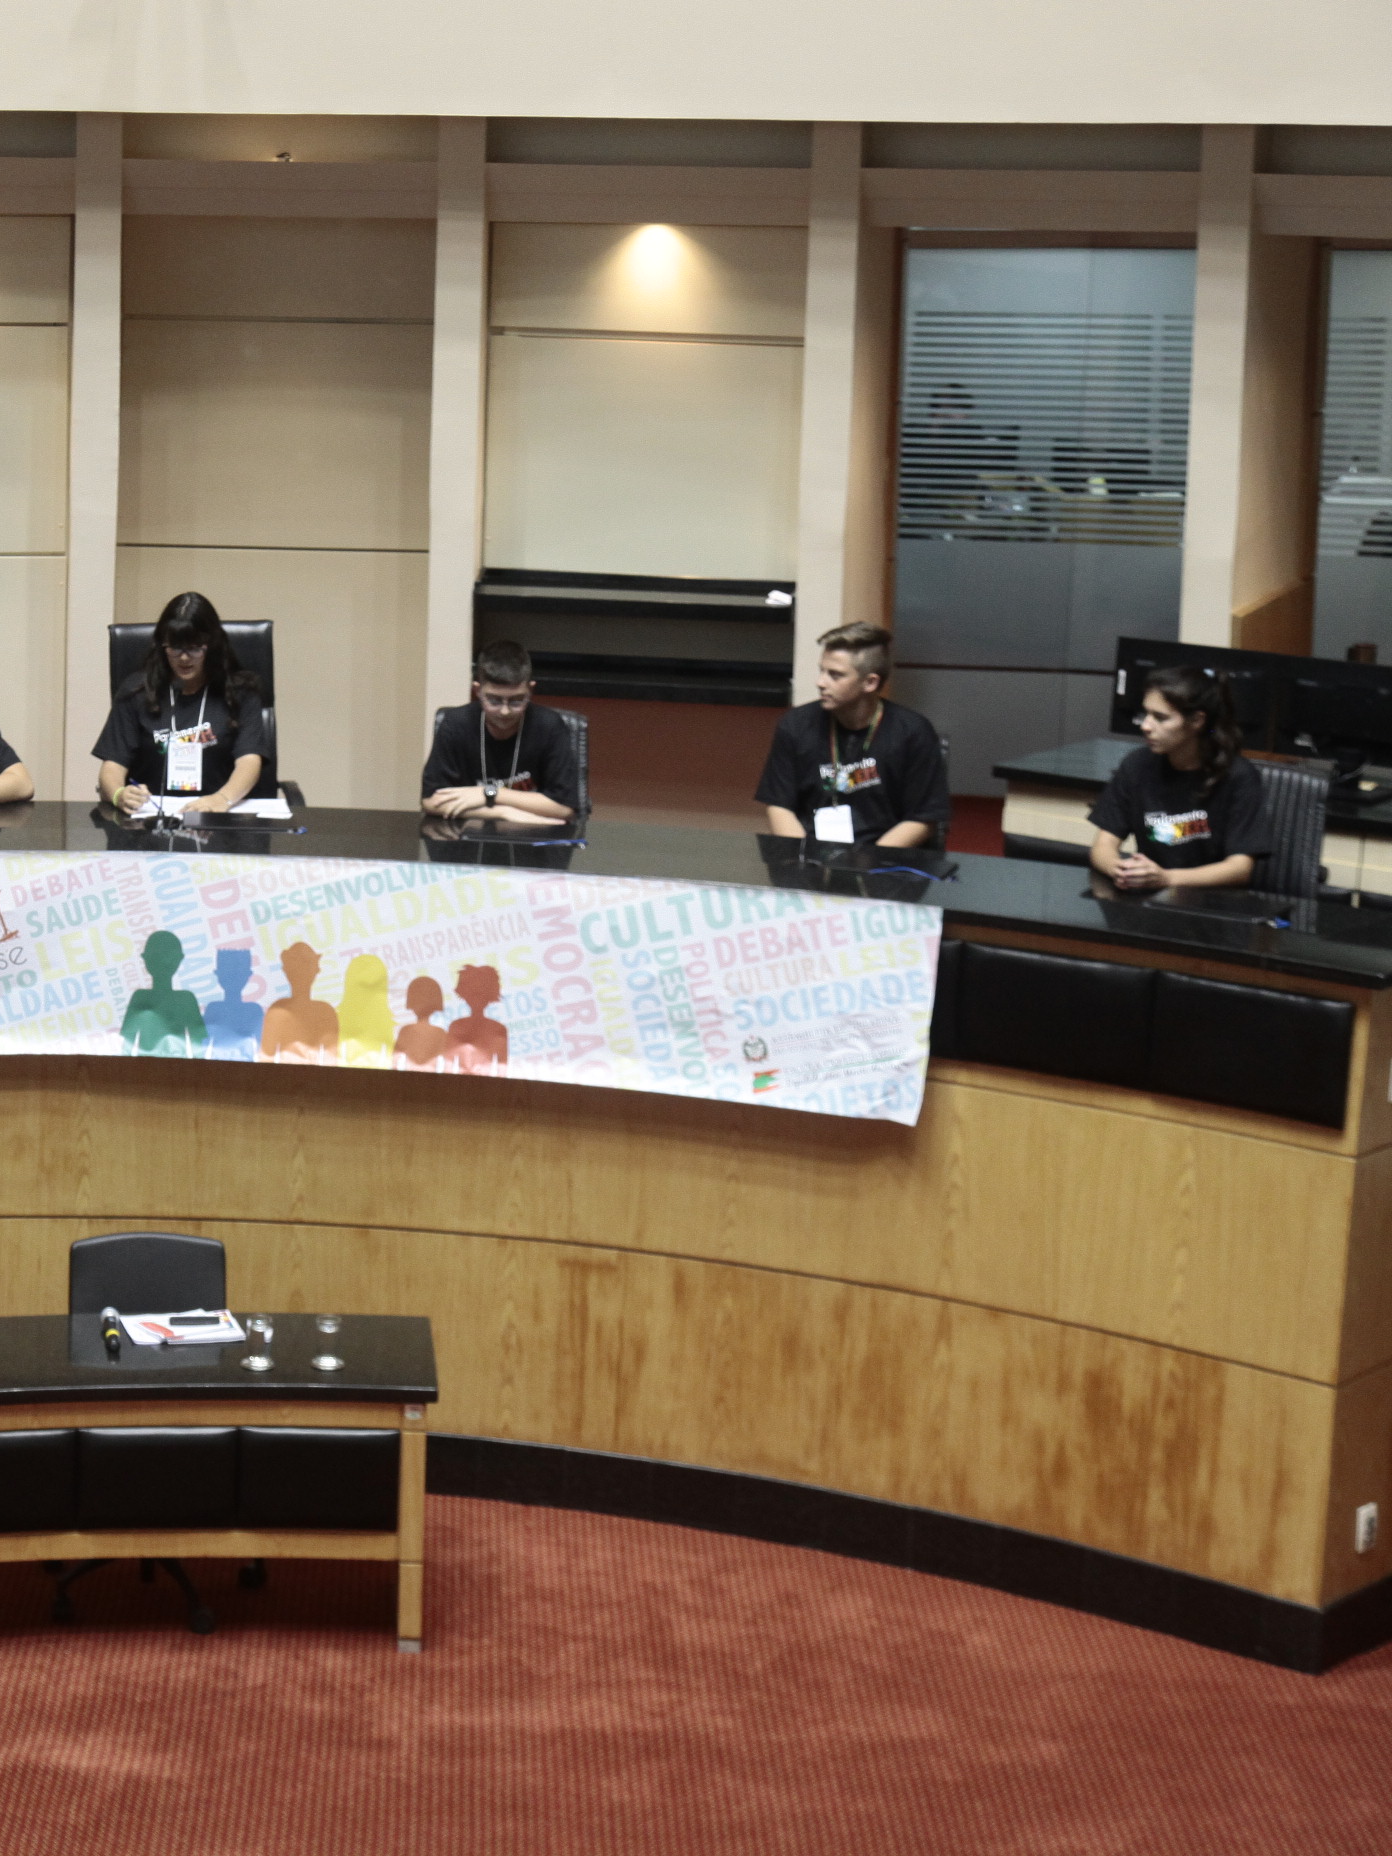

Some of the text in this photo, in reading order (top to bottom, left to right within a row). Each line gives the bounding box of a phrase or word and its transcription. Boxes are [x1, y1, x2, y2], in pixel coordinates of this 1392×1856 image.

[11, 859, 115, 908] DEBATE
[26, 889, 122, 939] SAÚDE
[258, 869, 517, 962] IGUALDADE
[579, 887, 807, 955] CULTURA
[713, 914, 849, 969] DEBATE
[34, 919, 135, 981] LEIS
[723, 954, 836, 997] CULTURA
[839, 938, 923, 977] LEIS
[733, 970, 929, 1031] SOCIEDADE
